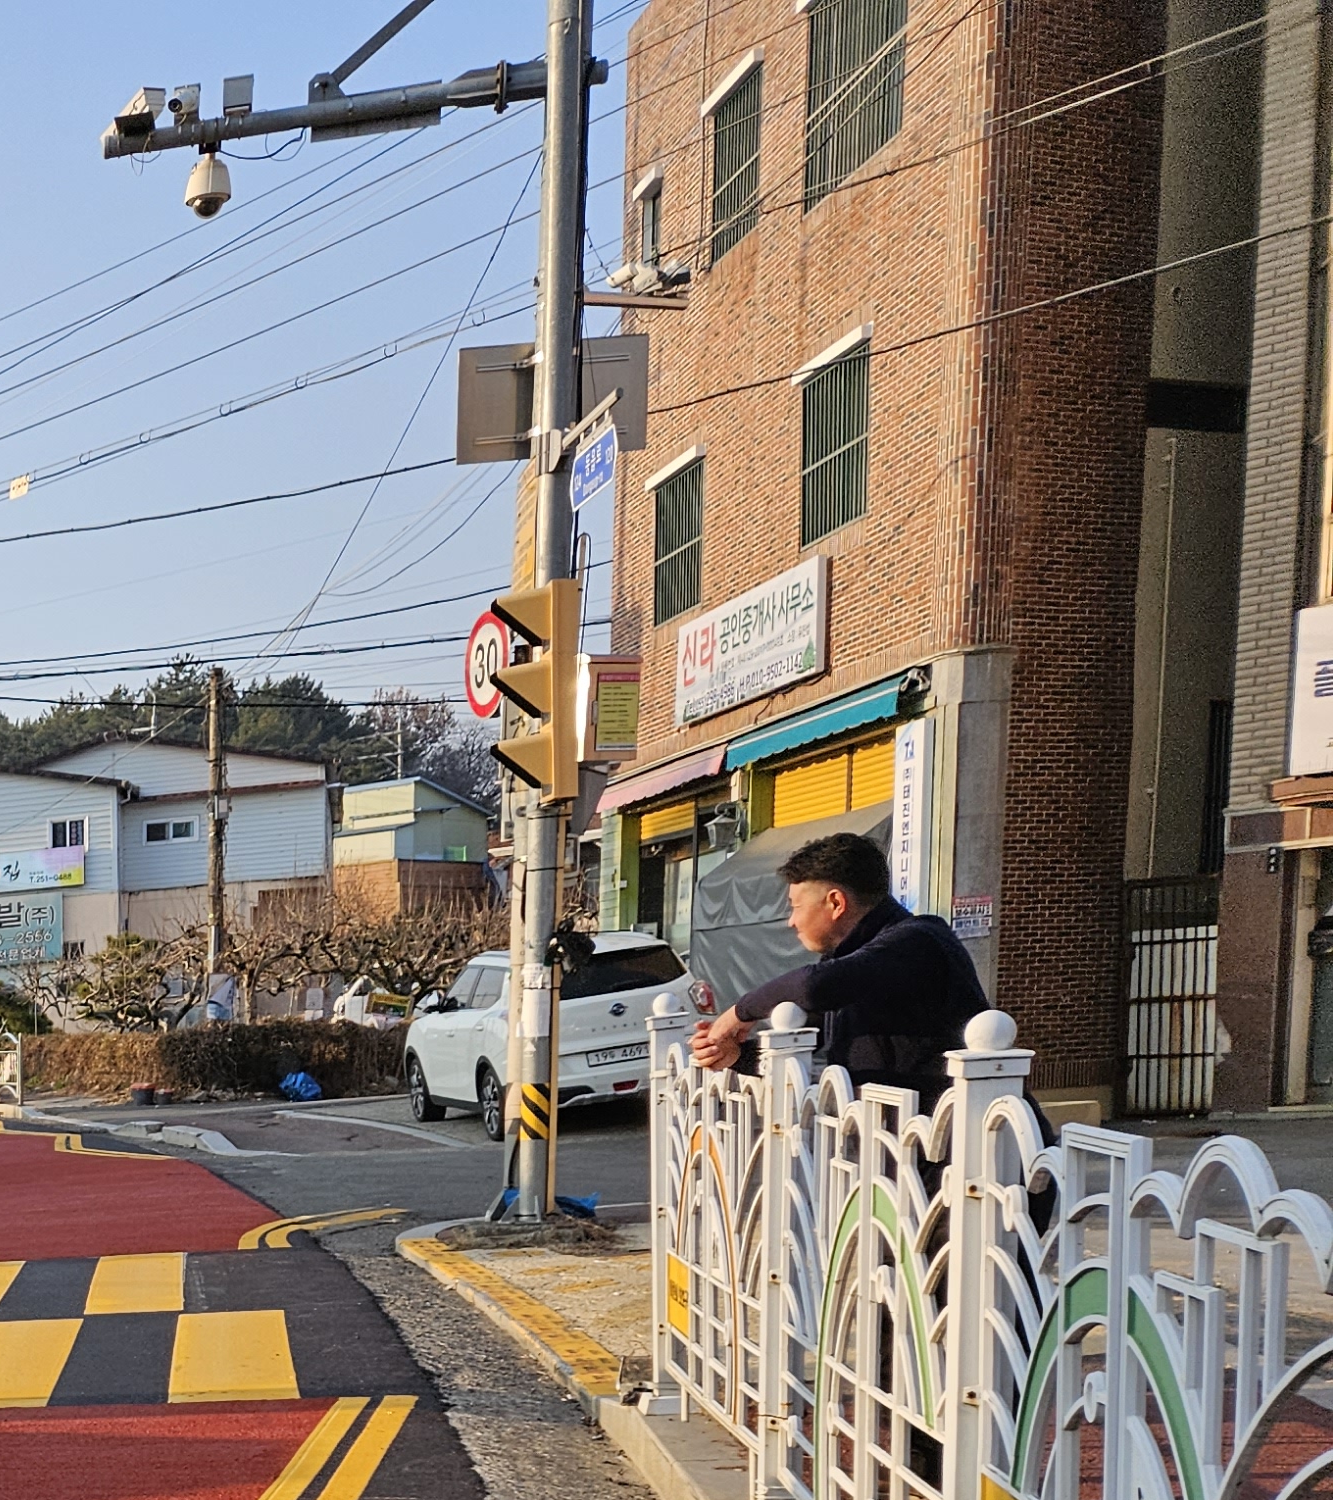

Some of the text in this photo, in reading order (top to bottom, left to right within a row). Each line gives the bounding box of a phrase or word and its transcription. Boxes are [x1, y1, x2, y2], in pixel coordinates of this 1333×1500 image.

[475, 638, 498, 689] 30
[682, 622, 717, 687] 신라
[719, 591, 776, 655] 공인중개사
[777, 577, 814, 625] 사무소
